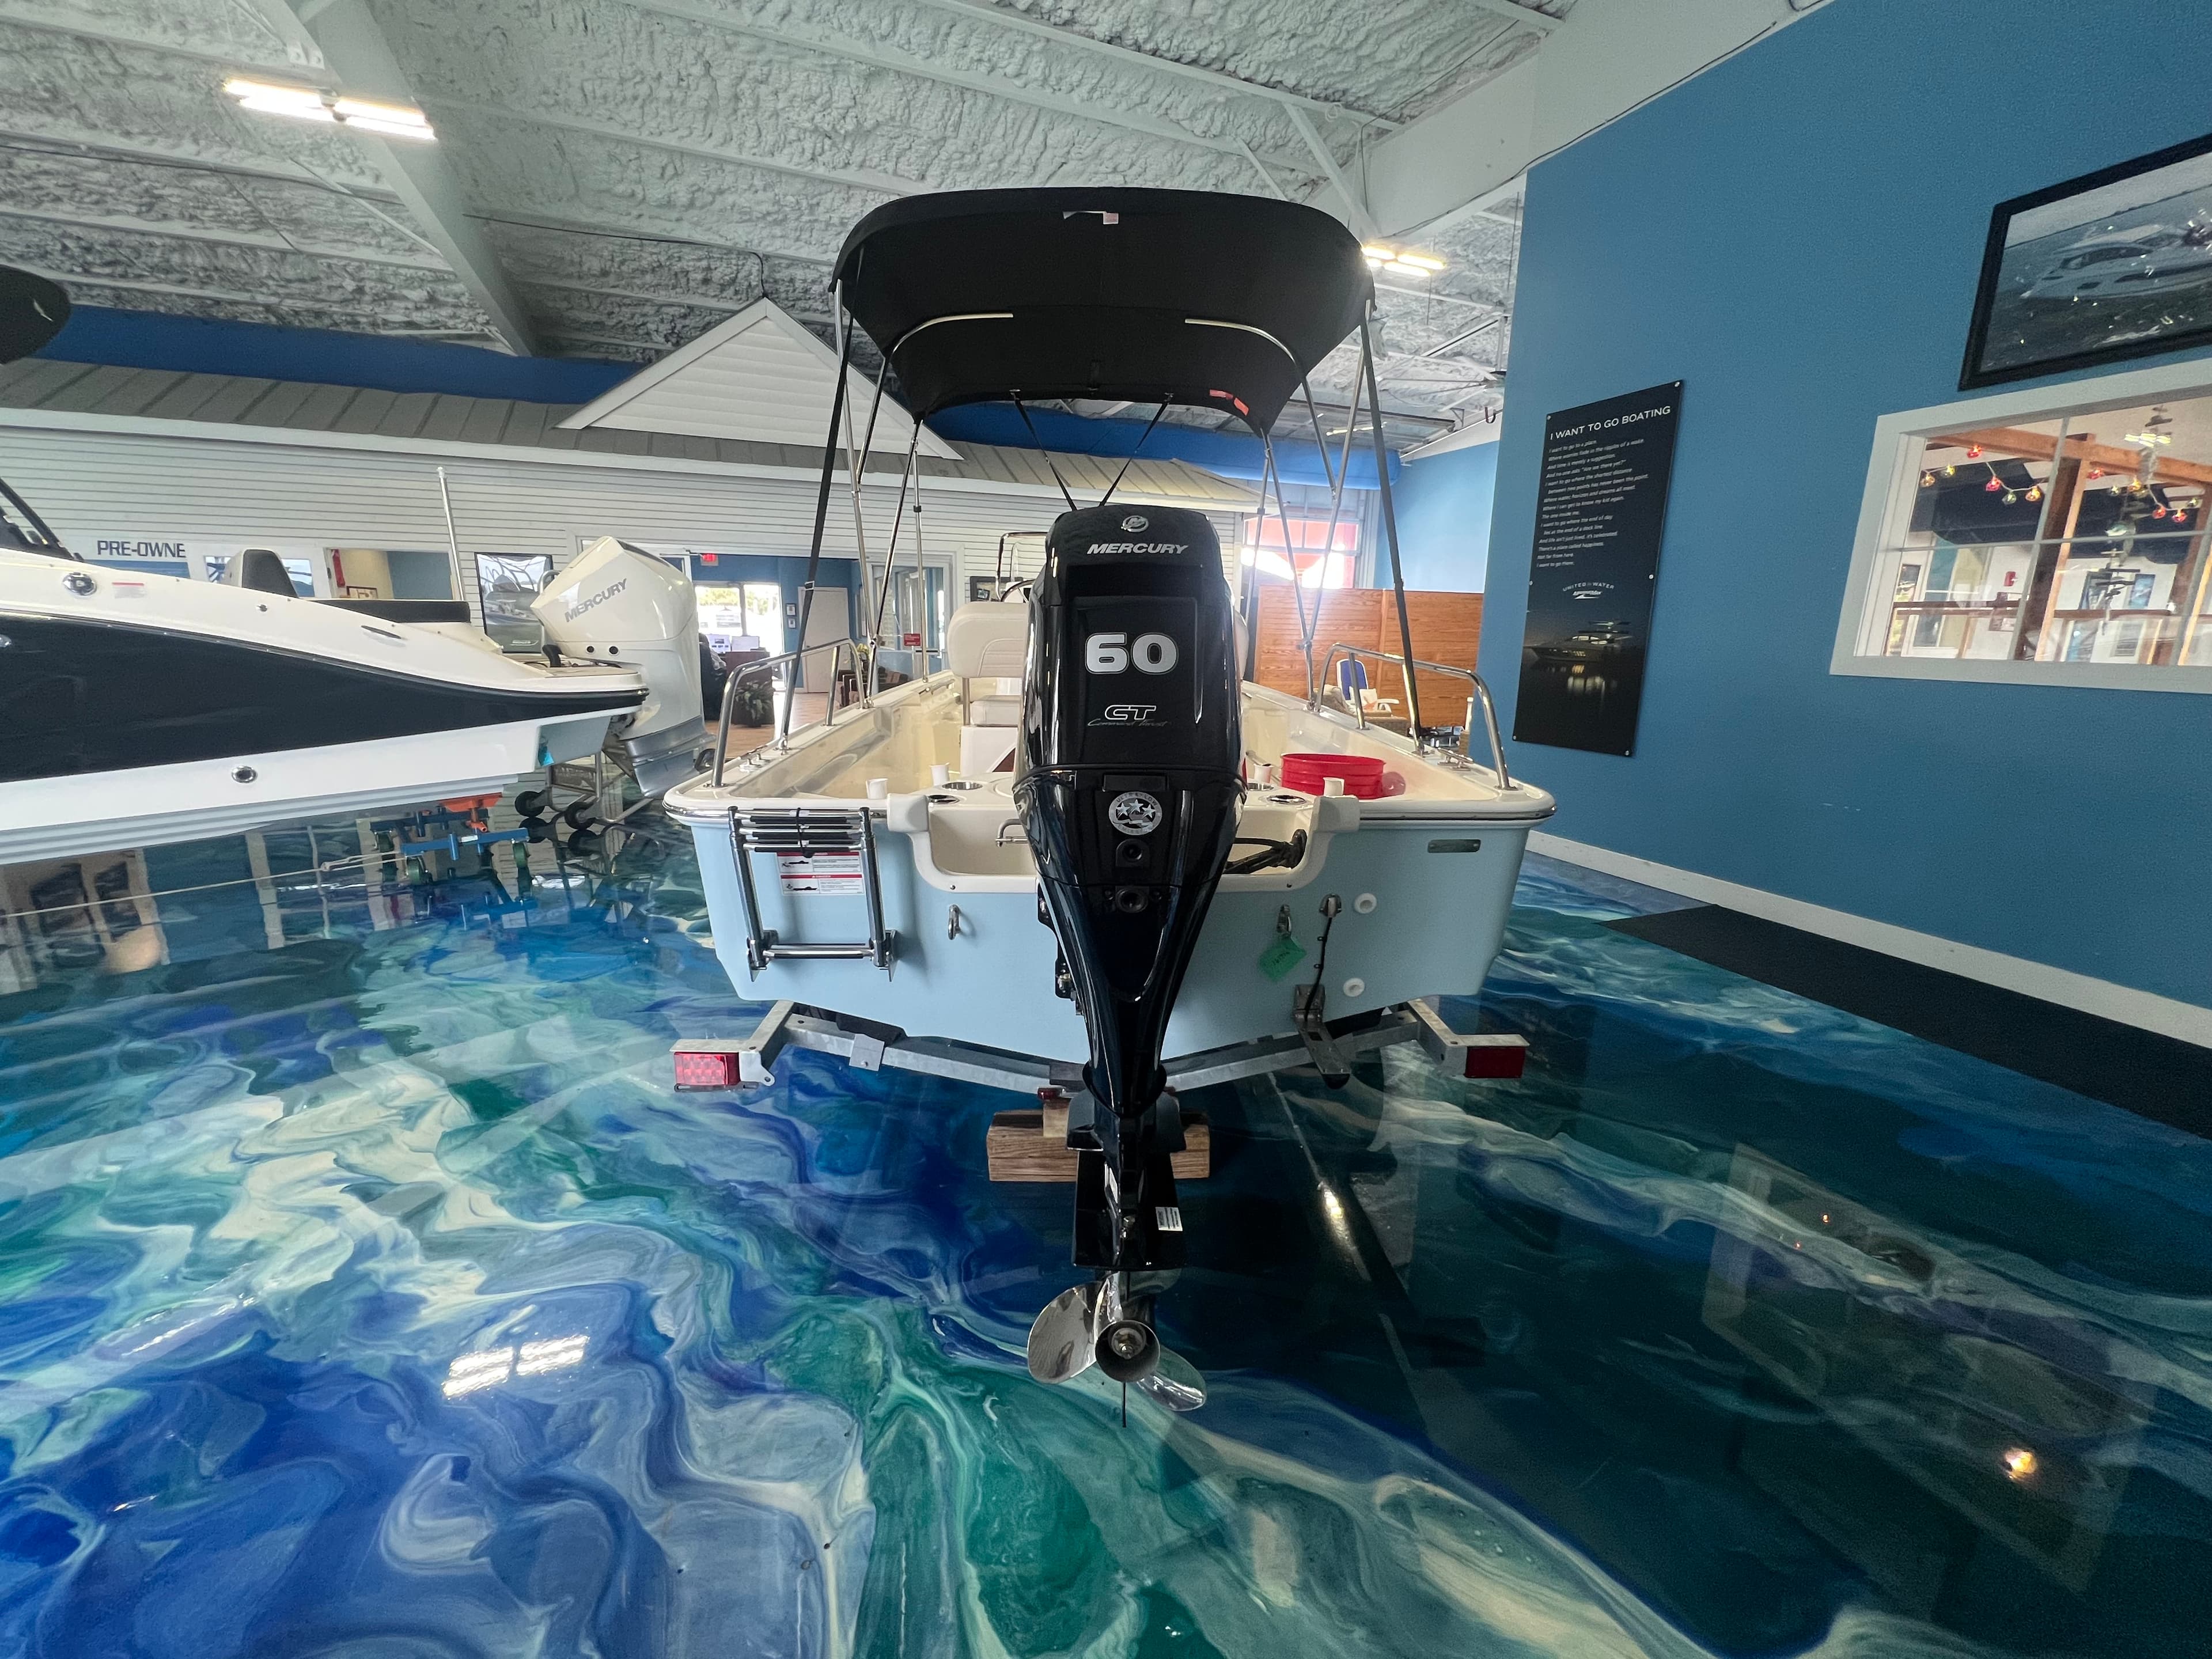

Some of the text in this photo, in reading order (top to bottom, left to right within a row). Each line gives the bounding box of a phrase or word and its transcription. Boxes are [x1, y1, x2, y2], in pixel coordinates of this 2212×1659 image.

[1555, 425, 1585, 440] WANT
[1588, 422, 1601, 431] TO
[1604, 418, 1619, 428] GO
[1622, 406, 1671, 425] BOATING
[97, 540, 186, 558] PRE-OWNE
[1087, 543, 1188, 554] MERCURY
[1563, 582, 1586, 592] UNITED
[565, 578, 627, 623] MERCURY
[1085, 632, 1179, 675] 60
[1104, 704, 1156, 720] CT
